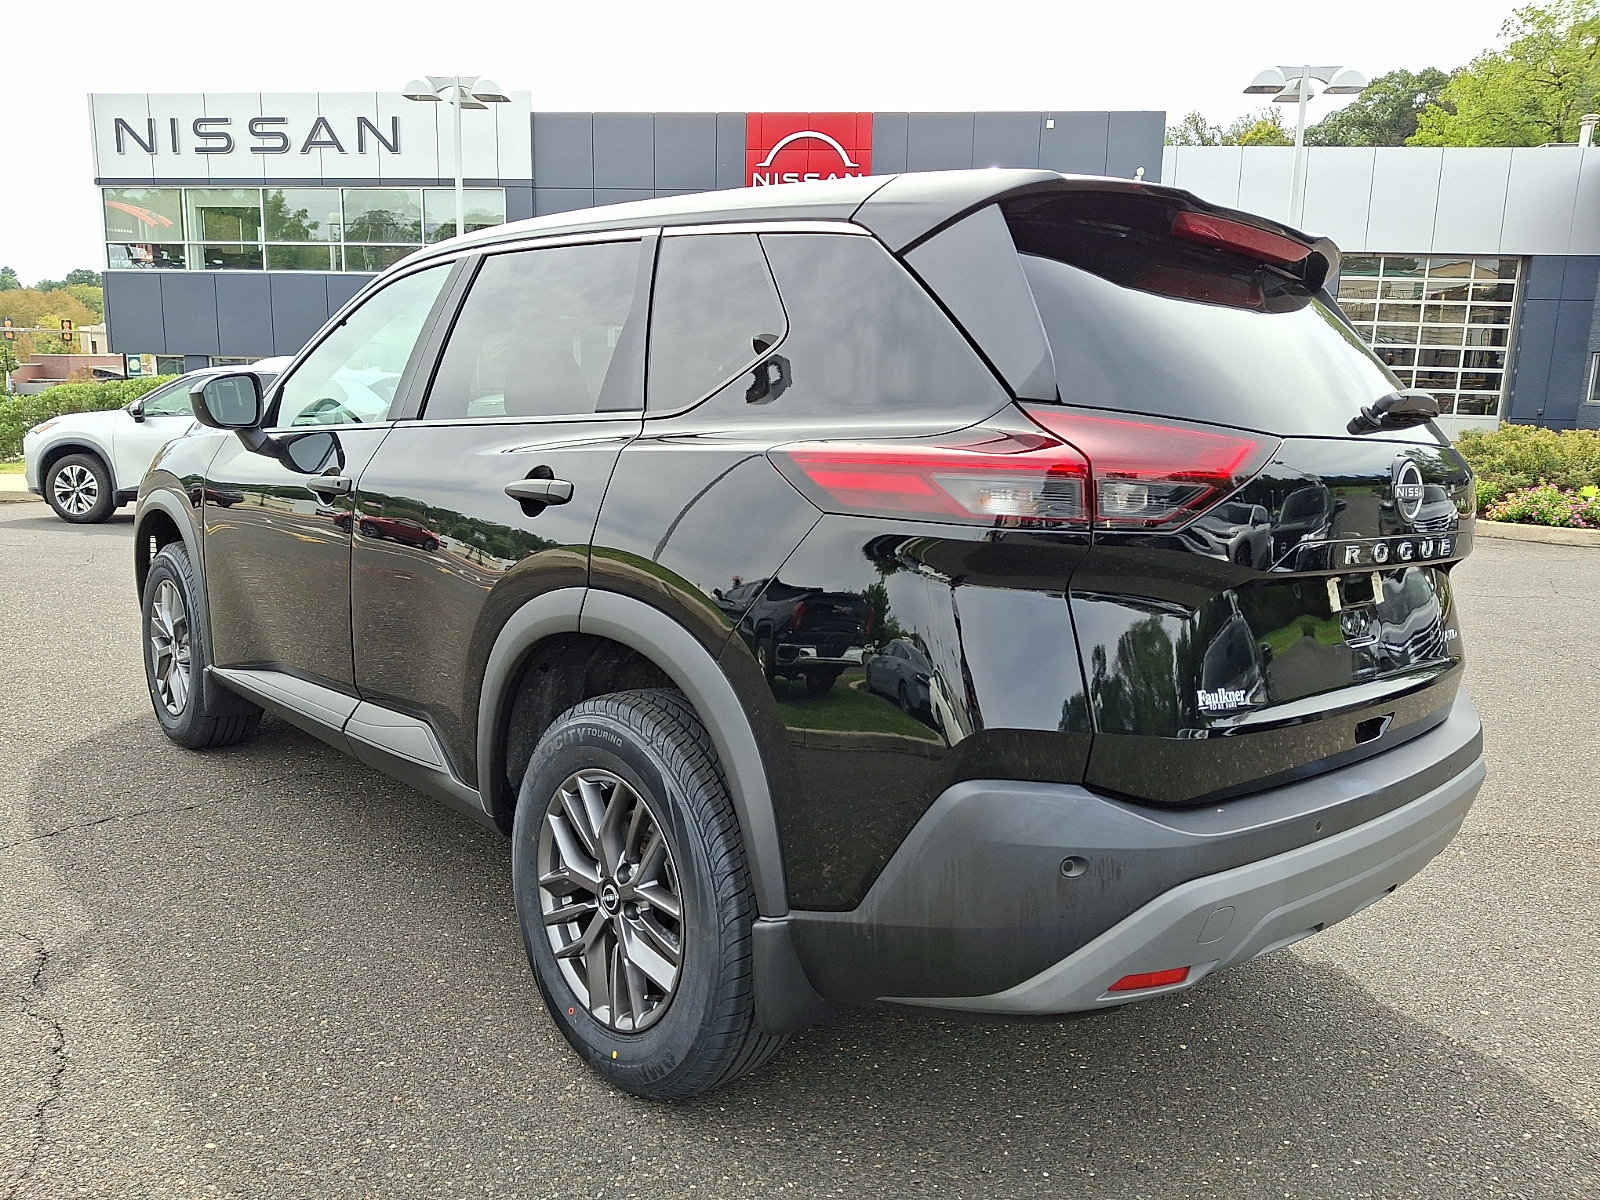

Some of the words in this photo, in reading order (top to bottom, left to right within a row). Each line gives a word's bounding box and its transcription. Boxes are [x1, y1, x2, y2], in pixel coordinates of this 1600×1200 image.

[115, 116, 400, 154] NISSAN
[1396, 487, 1423, 497] NISSA
[1344, 538, 1451, 565] ROGUE
[1196, 687, 1246, 707] Faulkner
[586, 727, 623, 748] TOURING
